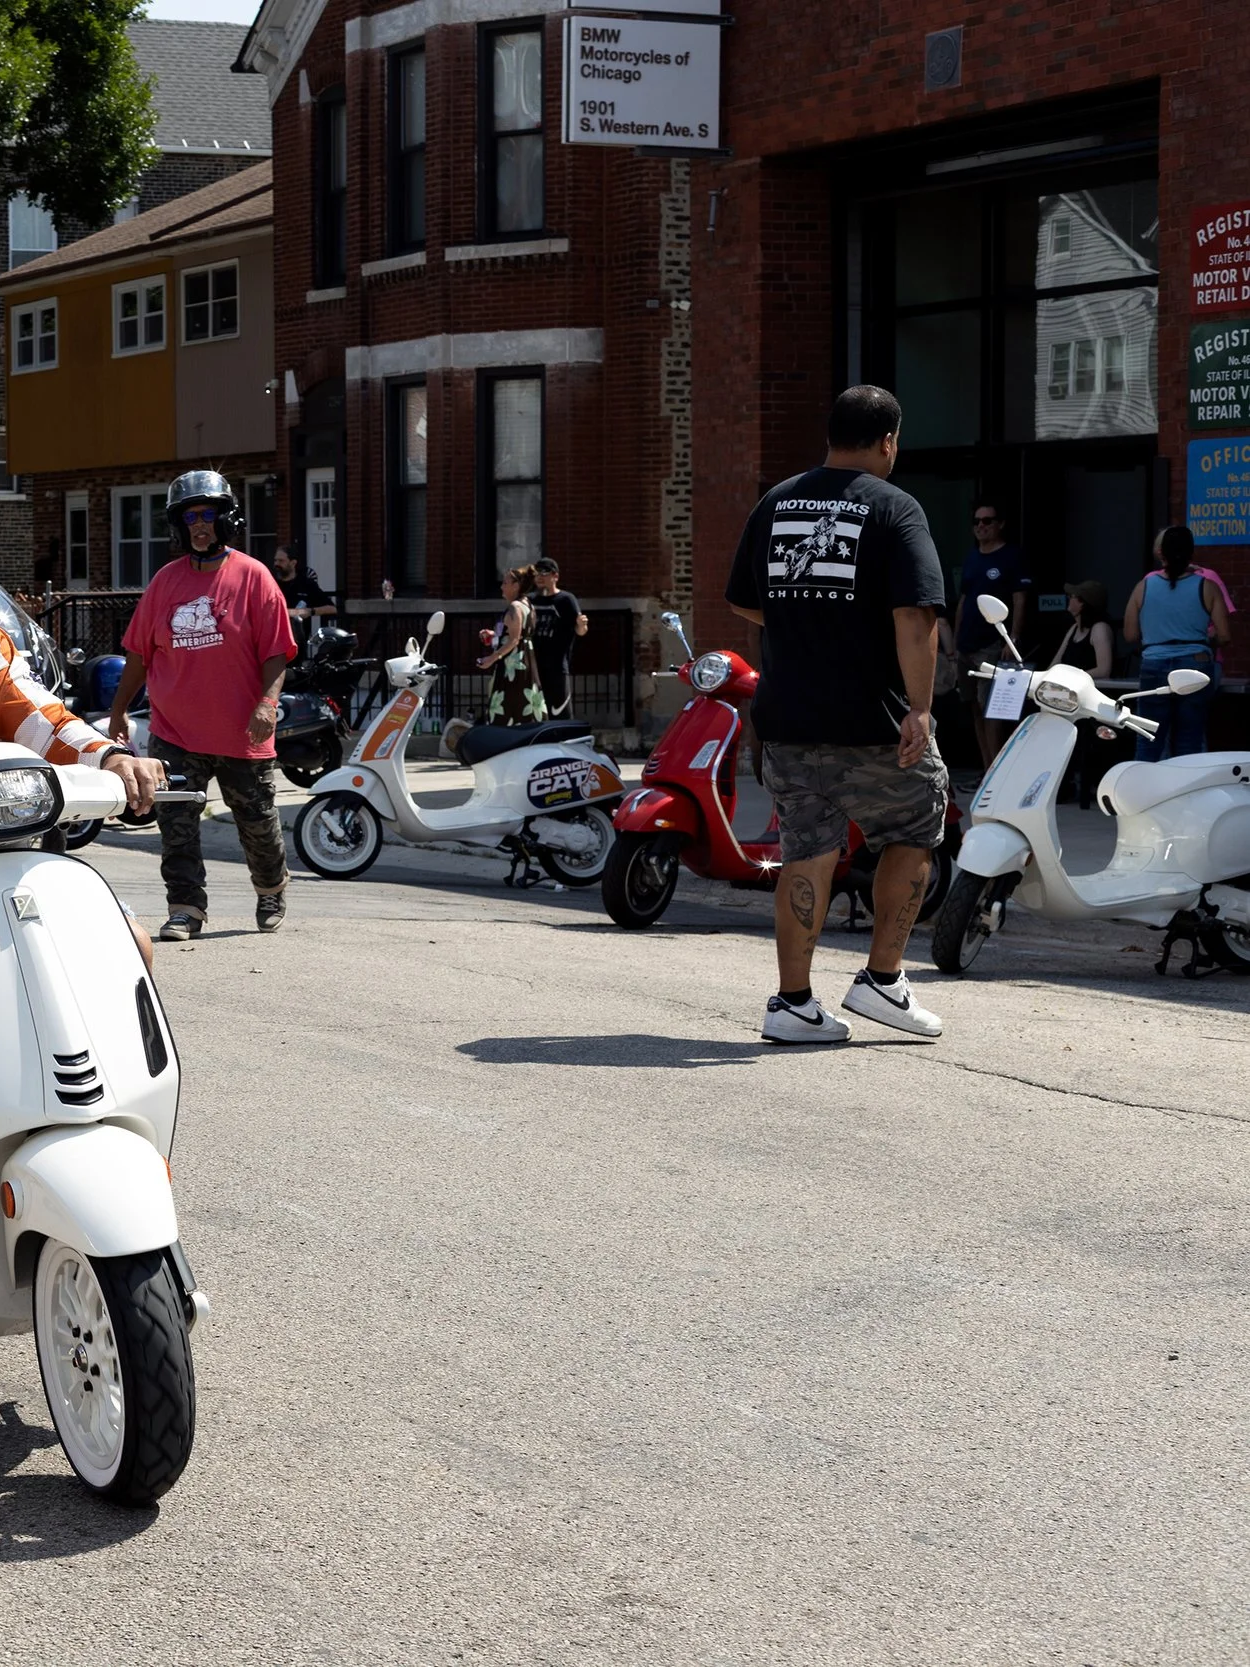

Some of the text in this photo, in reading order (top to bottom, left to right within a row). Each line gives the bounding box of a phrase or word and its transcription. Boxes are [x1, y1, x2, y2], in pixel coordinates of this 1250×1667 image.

[580, 27, 621, 43] BMW
[580, 45, 690, 66] Motorcycles of
[580, 63, 642, 84] Chicago
[580, 100, 615, 115] 1901
[580, 117, 709, 138] S. Western Ave. S
[1196, 209, 1250, 247] REGIST
[1227, 237, 1242, 249] No.
[1209, 253, 1232, 265] STATE
[1233, 251, 1244, 262] OF
[1193, 268, 1237, 287] MOTOR
[1197, 287, 1238, 305] RETAIL
[1194, 328, 1249, 363] REGIST
[1228, 356, 1241, 366] No.
[1206, 370, 1230, 382] STATE
[1231, 369, 1242, 380] OF
[1190, 386, 1236, 403] MOTOR
[1197, 404, 1241, 421] REPAIR
[1200, 445, 1250, 472] OFFIC
[1206, 487, 1230, 498] STATE
[1230, 486, 1241, 498] OF
[775, 499, 870, 515] MOTOWORKS
[1190, 503, 1236, 517] MOTOR
[768, 590, 855, 601] CHICAGO
[172, 633, 224, 648] AMERIVESPA
[530, 760, 590, 780] ORANGE
[530, 769, 588, 797] CAT
